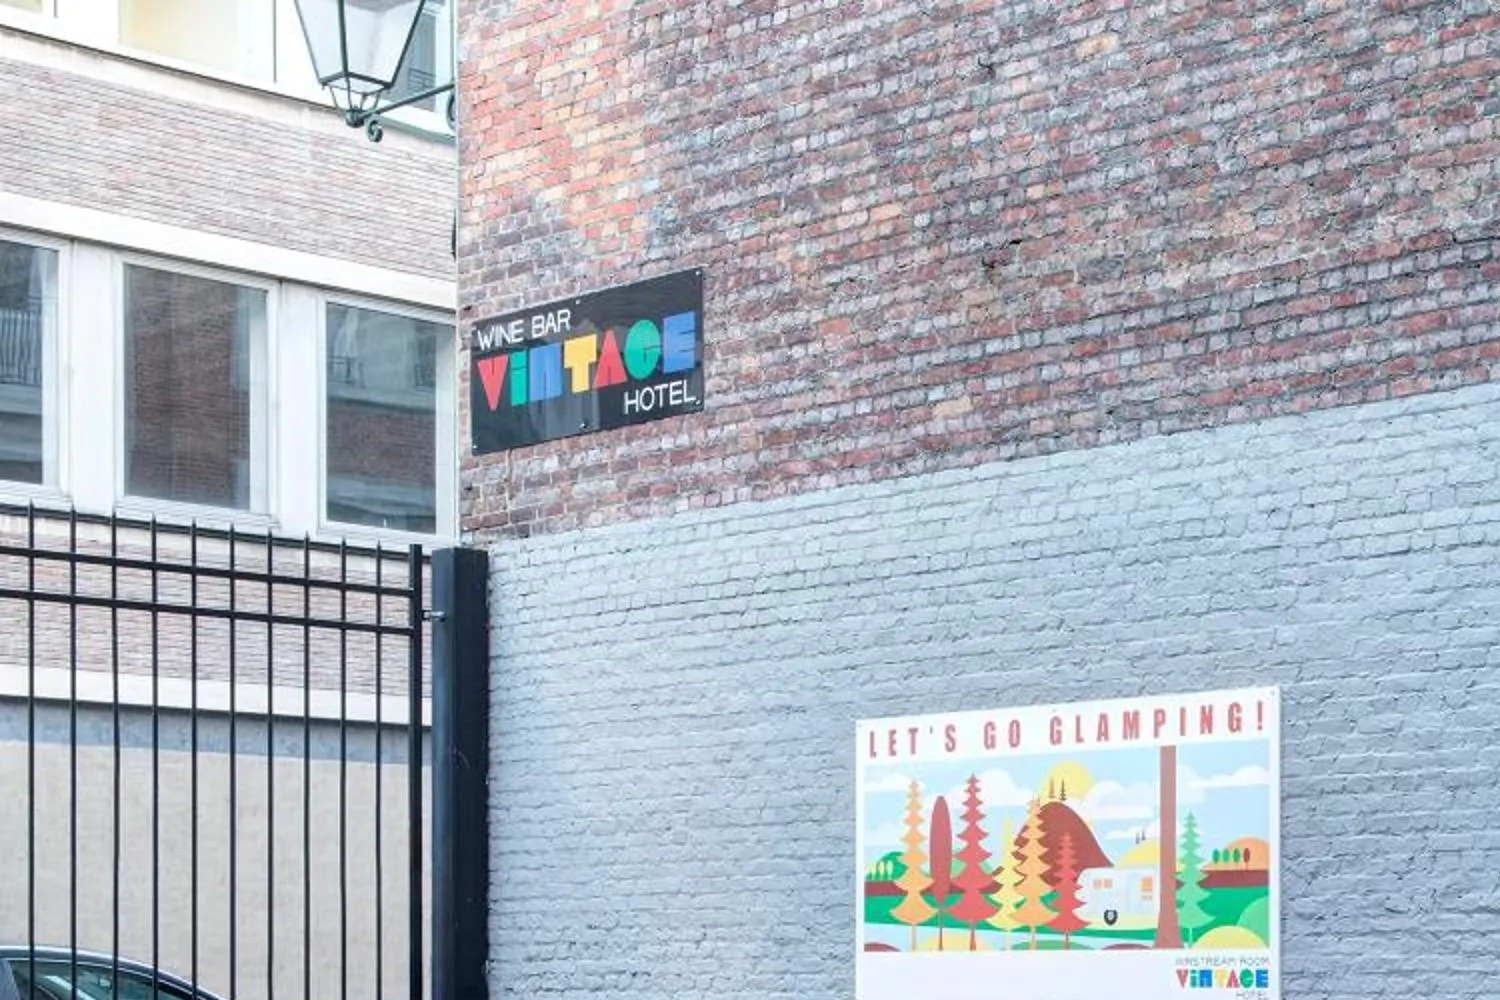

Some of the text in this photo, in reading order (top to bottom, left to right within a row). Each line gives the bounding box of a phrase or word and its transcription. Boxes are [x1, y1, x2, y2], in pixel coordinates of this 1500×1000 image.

[477, 308, 571, 351] WINE BAR
[624, 380, 696, 415] HOTEL
[869, 700, 1264, 758] LET'S GO GLAMPING!
